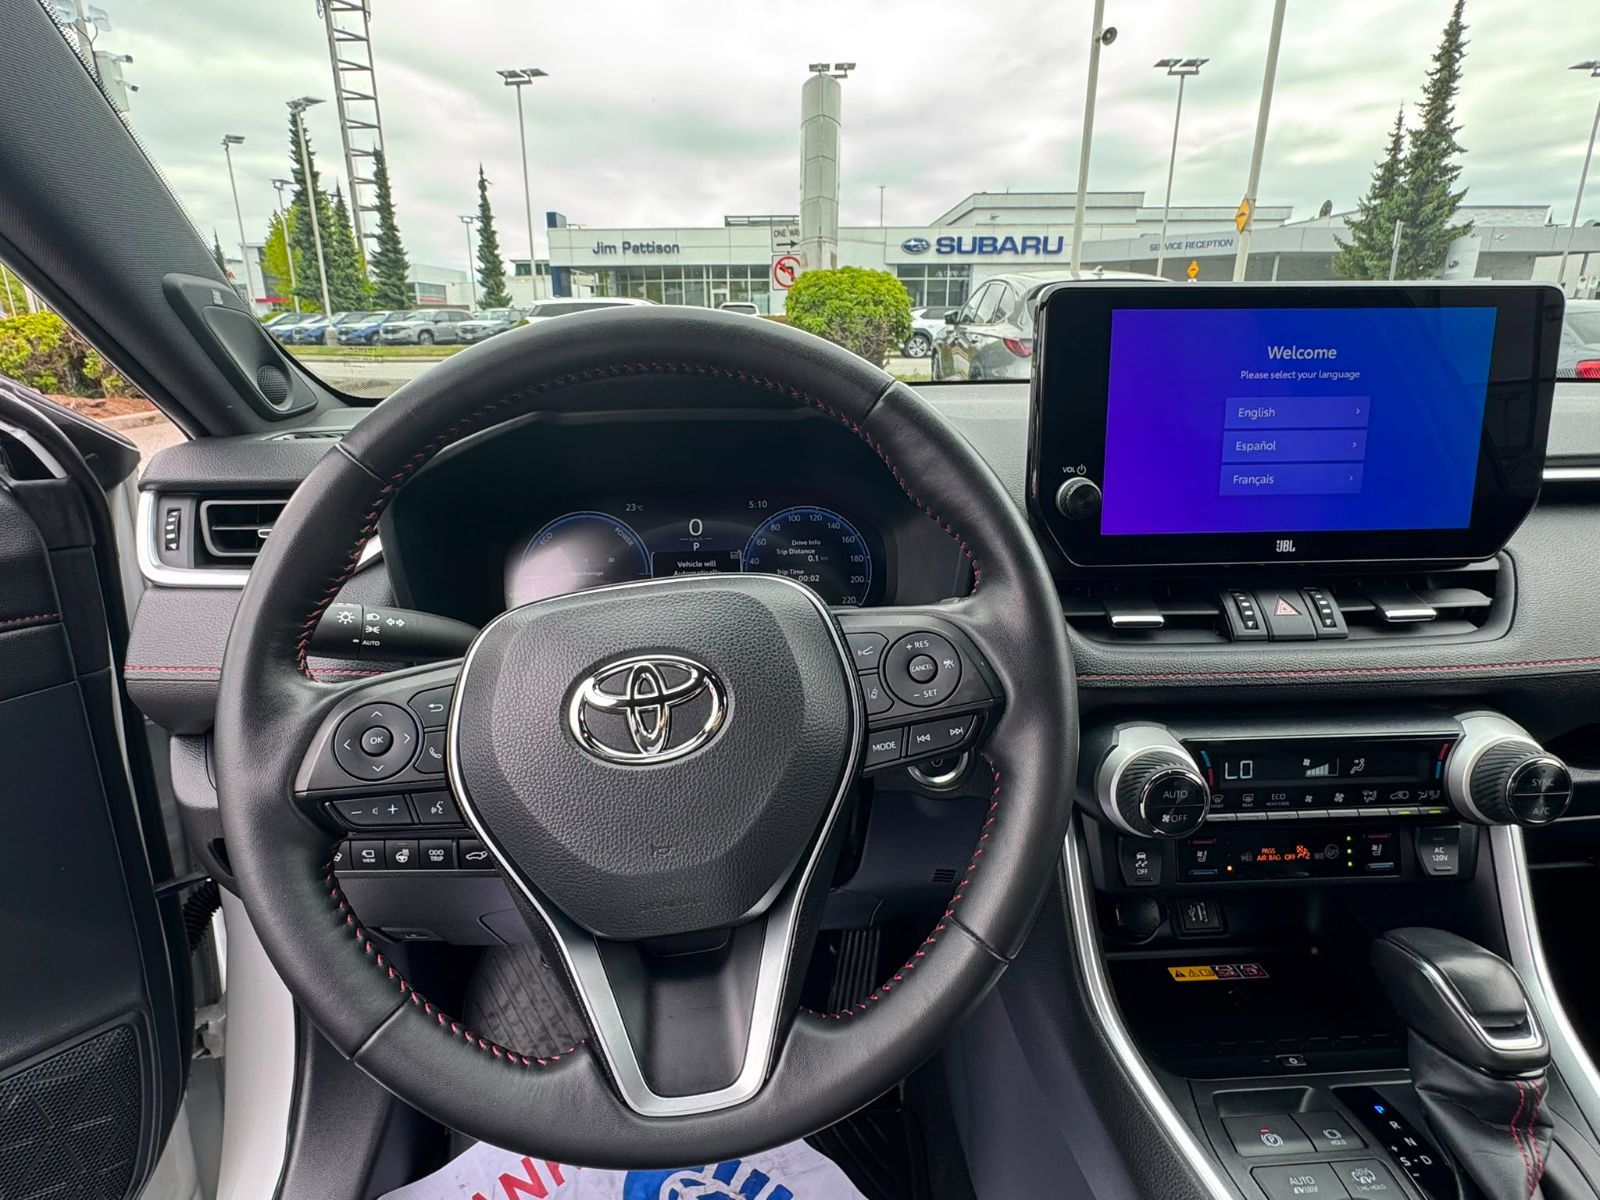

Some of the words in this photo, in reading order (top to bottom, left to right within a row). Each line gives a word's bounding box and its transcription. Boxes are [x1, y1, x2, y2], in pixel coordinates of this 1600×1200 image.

[789, 229, 800, 237] WA
[592, 241, 617, 255] Jim
[622, 240, 680, 254] Pattison
[936, 236, 1064, 255] SUBARU
[1150, 242, 1183, 252] SEVICE
[1185, 239, 1234, 250] RECEPTION
[1267, 345, 1337, 360] Welcome
[1240, 370, 1268, 379] Please
[1270, 370, 1296, 379] select
[1297, 371, 1317, 381] your
[1318, 369, 1360, 380] language
[1238, 407, 1276, 420] English
[1235, 440, 1276, 453] Español
[1233, 474, 1275, 487] Français
[748, 500, 768, 508] 5:10
[788, 514, 801, 522] 100
[688, 518, 703, 536] 0
[770, 523, 781, 531] 80
[827, 522, 840, 530] 140
[842, 535, 855, 543] 160
[693, 542, 700, 552] P
[1276, 539, 1296, 553] JBL
[677, 560, 702, 568] Vehicle
[750, 557, 760, 565] 40
[850, 575, 865, 583] 200
[842, 596, 857, 604] 220
[914, 640, 929, 648] RES
[911, 663, 934, 672] CANCEL
[923, 688, 938, 697] SET
[370, 736, 384, 745] OK
[872, 741, 897, 752] MODE
[1225, 760, 1254, 780] LO
[1162, 790, 1188, 799] AUTO
[1532, 807, 1550, 816] A/C
[1170, 815, 1188, 823] OFF
[1284, 853, 1296, 861] OFF
[1431, 854, 1449, 862] 120V
[1374, 1105, 1385, 1114] P
[1389, 1121, 1402, 1130] R
[1403, 1137, 1417, 1147] N
[1419, 1155, 1433, 1165] D
[1289, 1175, 1315, 1186] AUTO
